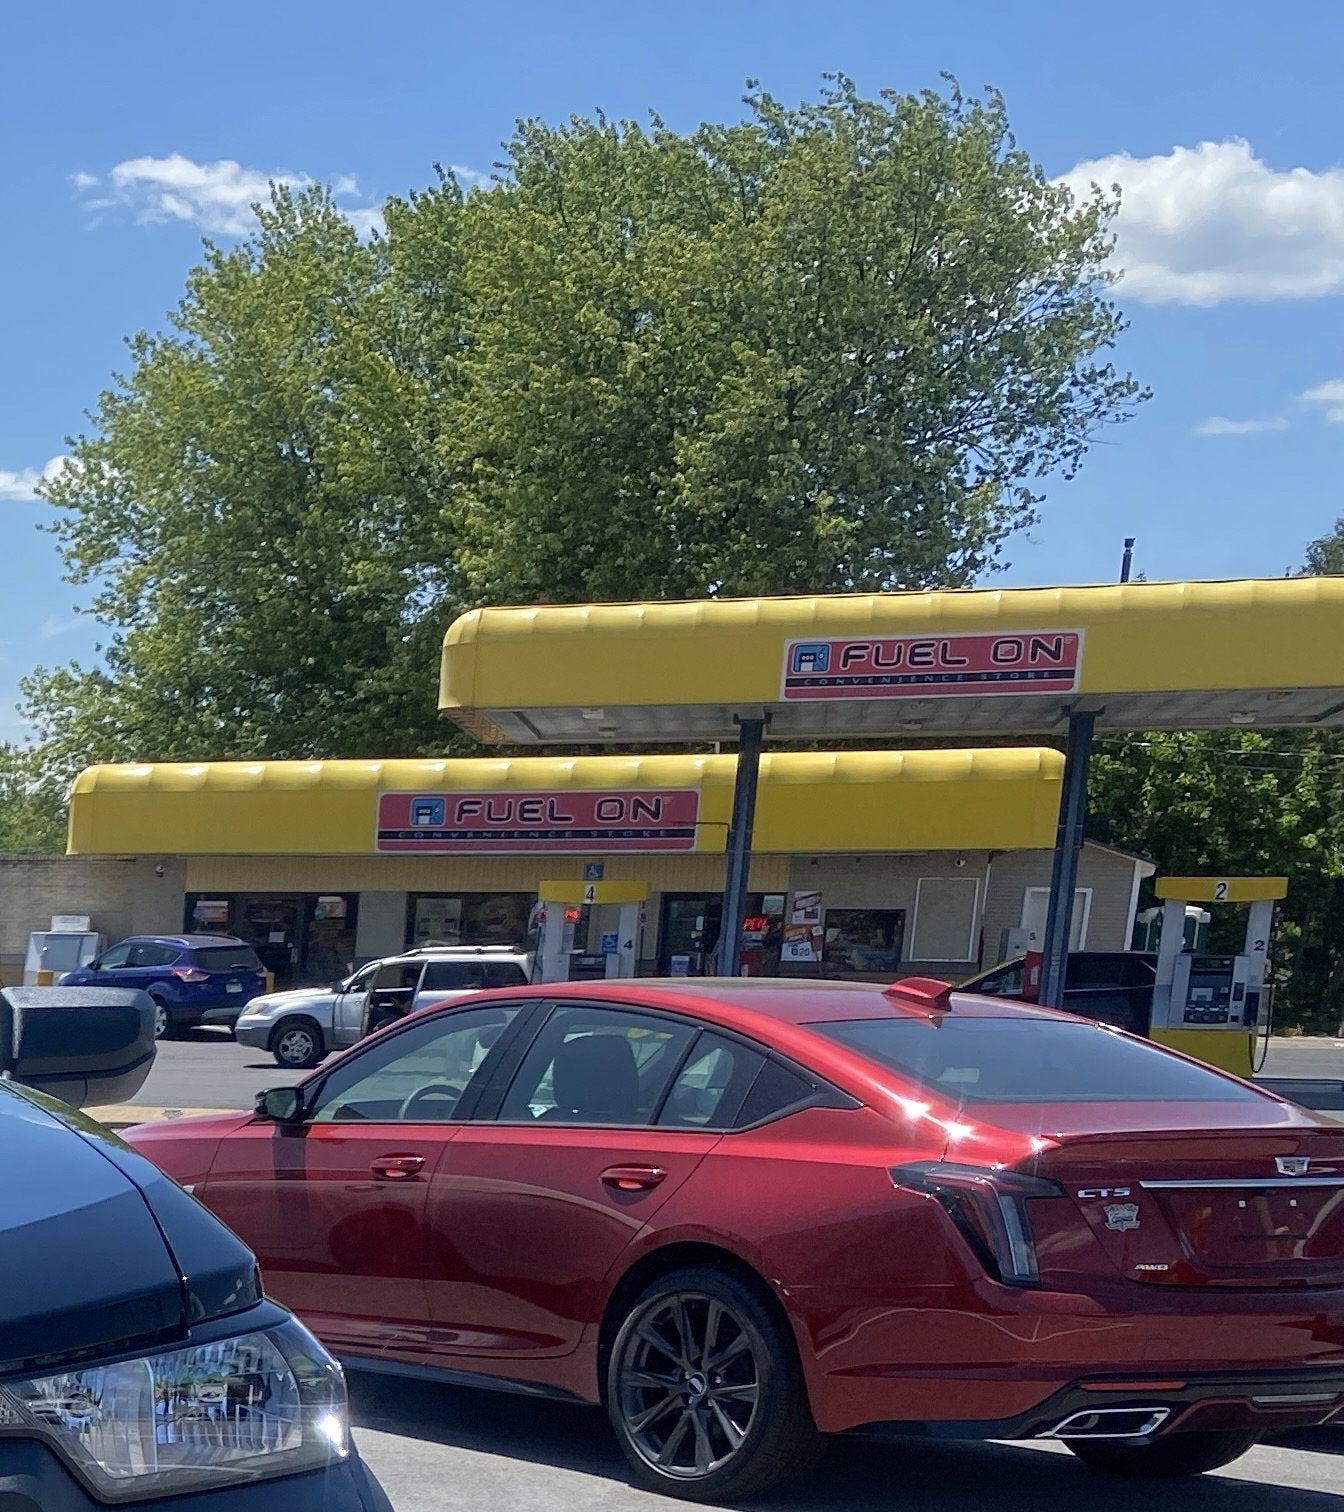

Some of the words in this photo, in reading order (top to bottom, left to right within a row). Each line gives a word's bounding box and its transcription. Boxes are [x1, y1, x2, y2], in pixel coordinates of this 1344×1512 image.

[840, 639, 968, 670] FUEL
[991, 635, 1064, 666] ON
[803, 674, 967, 686] CONVENIENCE
[980, 671, 1050, 681] STORE
[454, 799, 575, 824] FUEL
[594, 796, 663, 822] ON
[397, 830, 574, 839] CONVENIENCE
[590, 829, 665, 838] STORE
[586, 886, 595, 900] 4
[1215, 883, 1227, 900] 2
[743, 918, 768, 930] PEN
[623, 940, 633, 950] 4
[1253, 940, 1265, 951] 2
